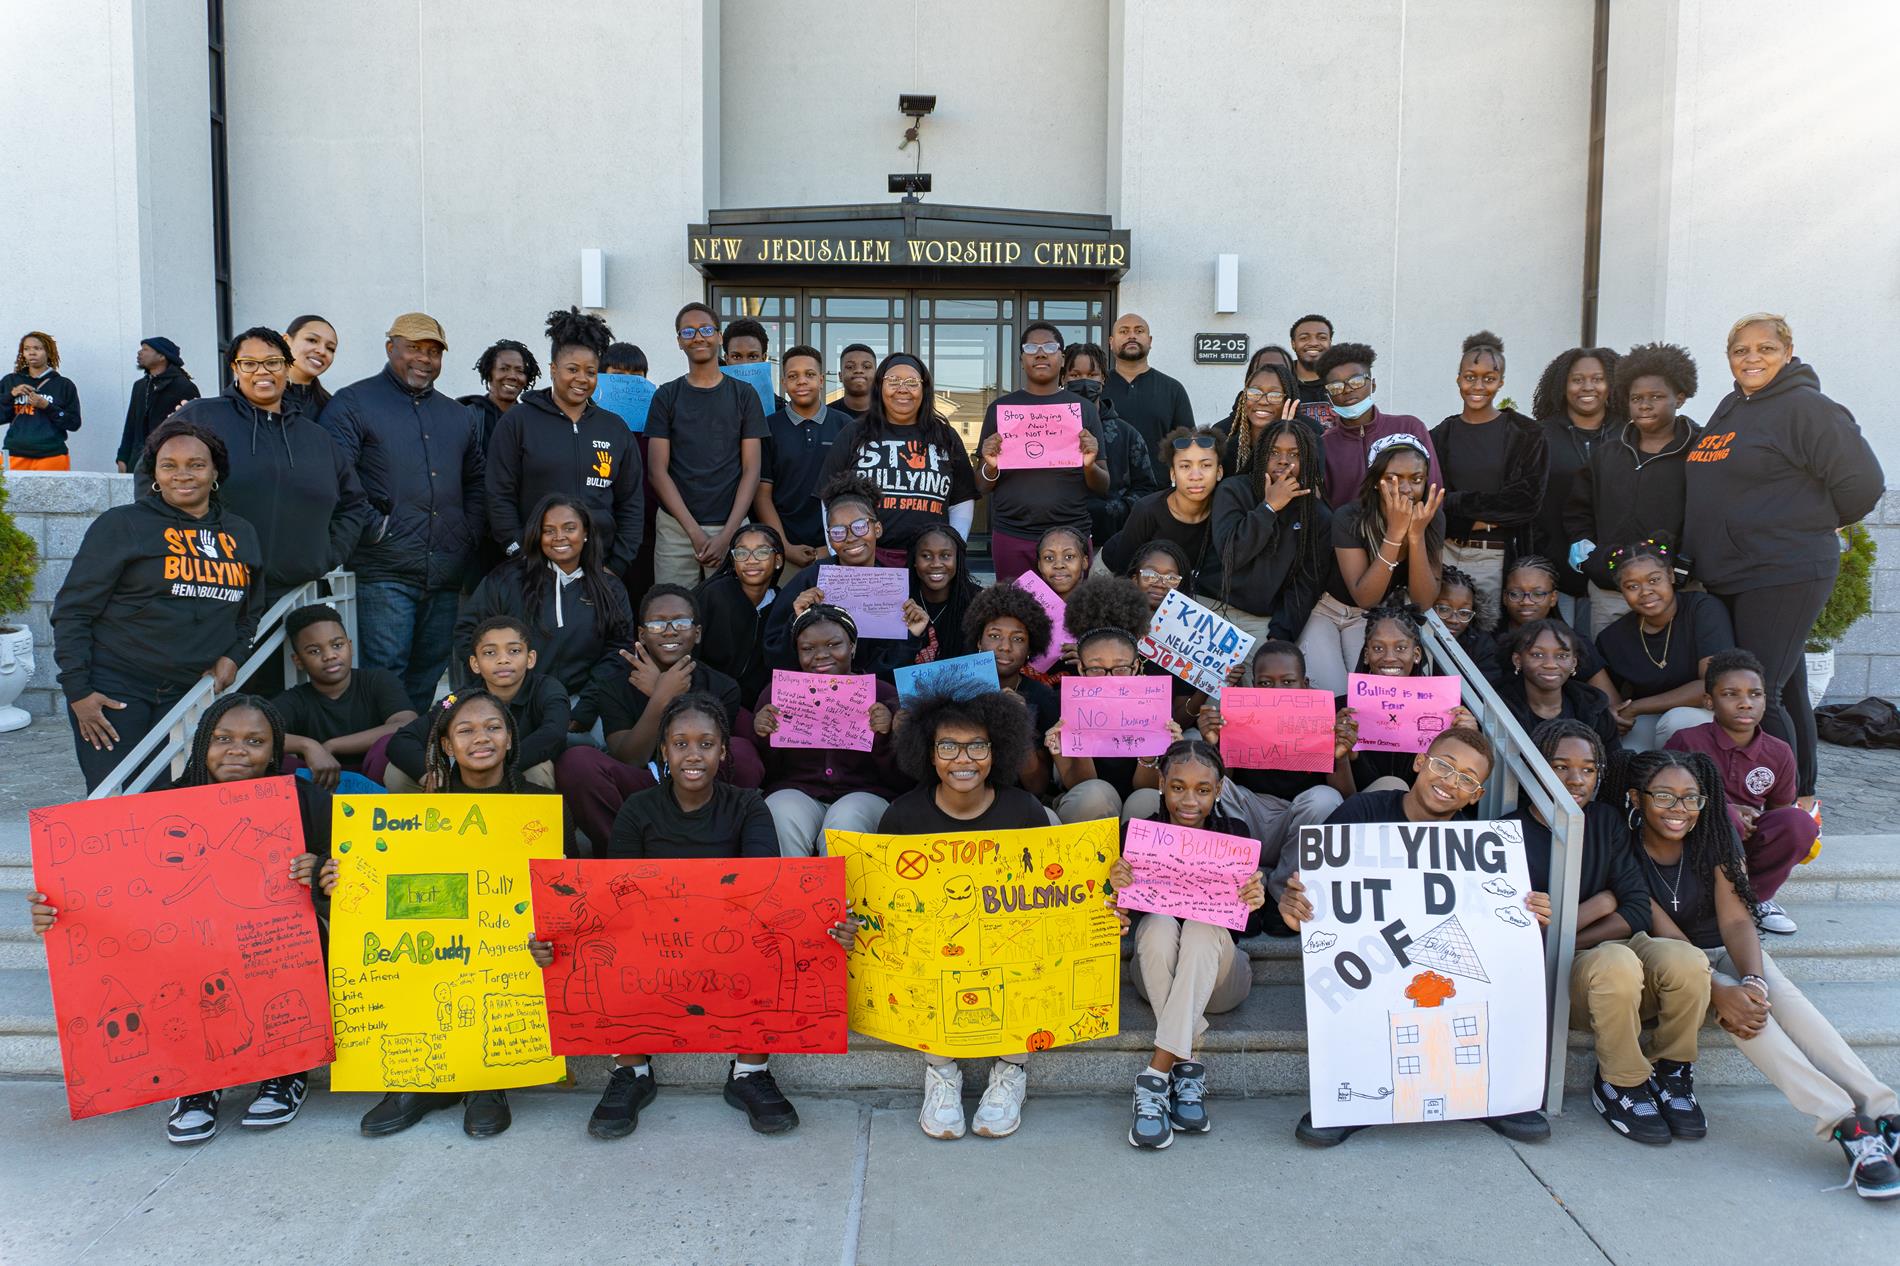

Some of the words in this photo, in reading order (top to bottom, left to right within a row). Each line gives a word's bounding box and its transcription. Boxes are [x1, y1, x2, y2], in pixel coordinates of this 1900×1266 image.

[693, 238, 743, 261] NEW
[757, 239, 891, 263] JERUSALEM
[908, 240, 1021, 264] WORSHIP
[1034, 242, 1126, 266] CENTER
[1198, 339, 1246, 351] 122-05
[592, 440, 611, 450] STOP
[899, 498, 928, 512] SPEAK
[1177, 601, 1239, 654] KIND
[1138, 636, 1186, 671] STOP
[1188, 630, 1204, 644] IS
[1207, 641, 1224, 656] THE
[1165, 634, 1194, 655] NEW
[1192, 651, 1226, 675] COOL
[1227, 694, 1326, 708] SQUASH
[1357, 681, 1397, 698] Bulling
[1403, 690, 1413, 699] is
[1381, 701, 1405, 710] Fair
[1078, 707, 1108, 729] NO
[1227, 738, 1305, 767] ELEVATE
[218, 787, 250, 806] Class
[254, 783, 279, 799] 801
[425, 807, 452, 832] Be
[458, 803, 488, 835] A
[929, 839, 1000, 865] STOP!
[1181, 830, 1252, 864] Bullying
[477, 870, 513, 895] Bully
[60, 877, 113, 913] be
[478, 910, 511, 928] Rude
[477, 939, 530, 958] Aggressi
[642, 932, 695, 948] HERE
[1425, 937, 1463, 964] Bullying
[659, 950, 684, 959] LIES
[332, 967, 356, 988] Be
[359, 972, 368, 983] A
[370, 970, 400, 982] Friend
[332, 991, 363, 1002] Unite
[367, 1020, 389, 1035] bully
